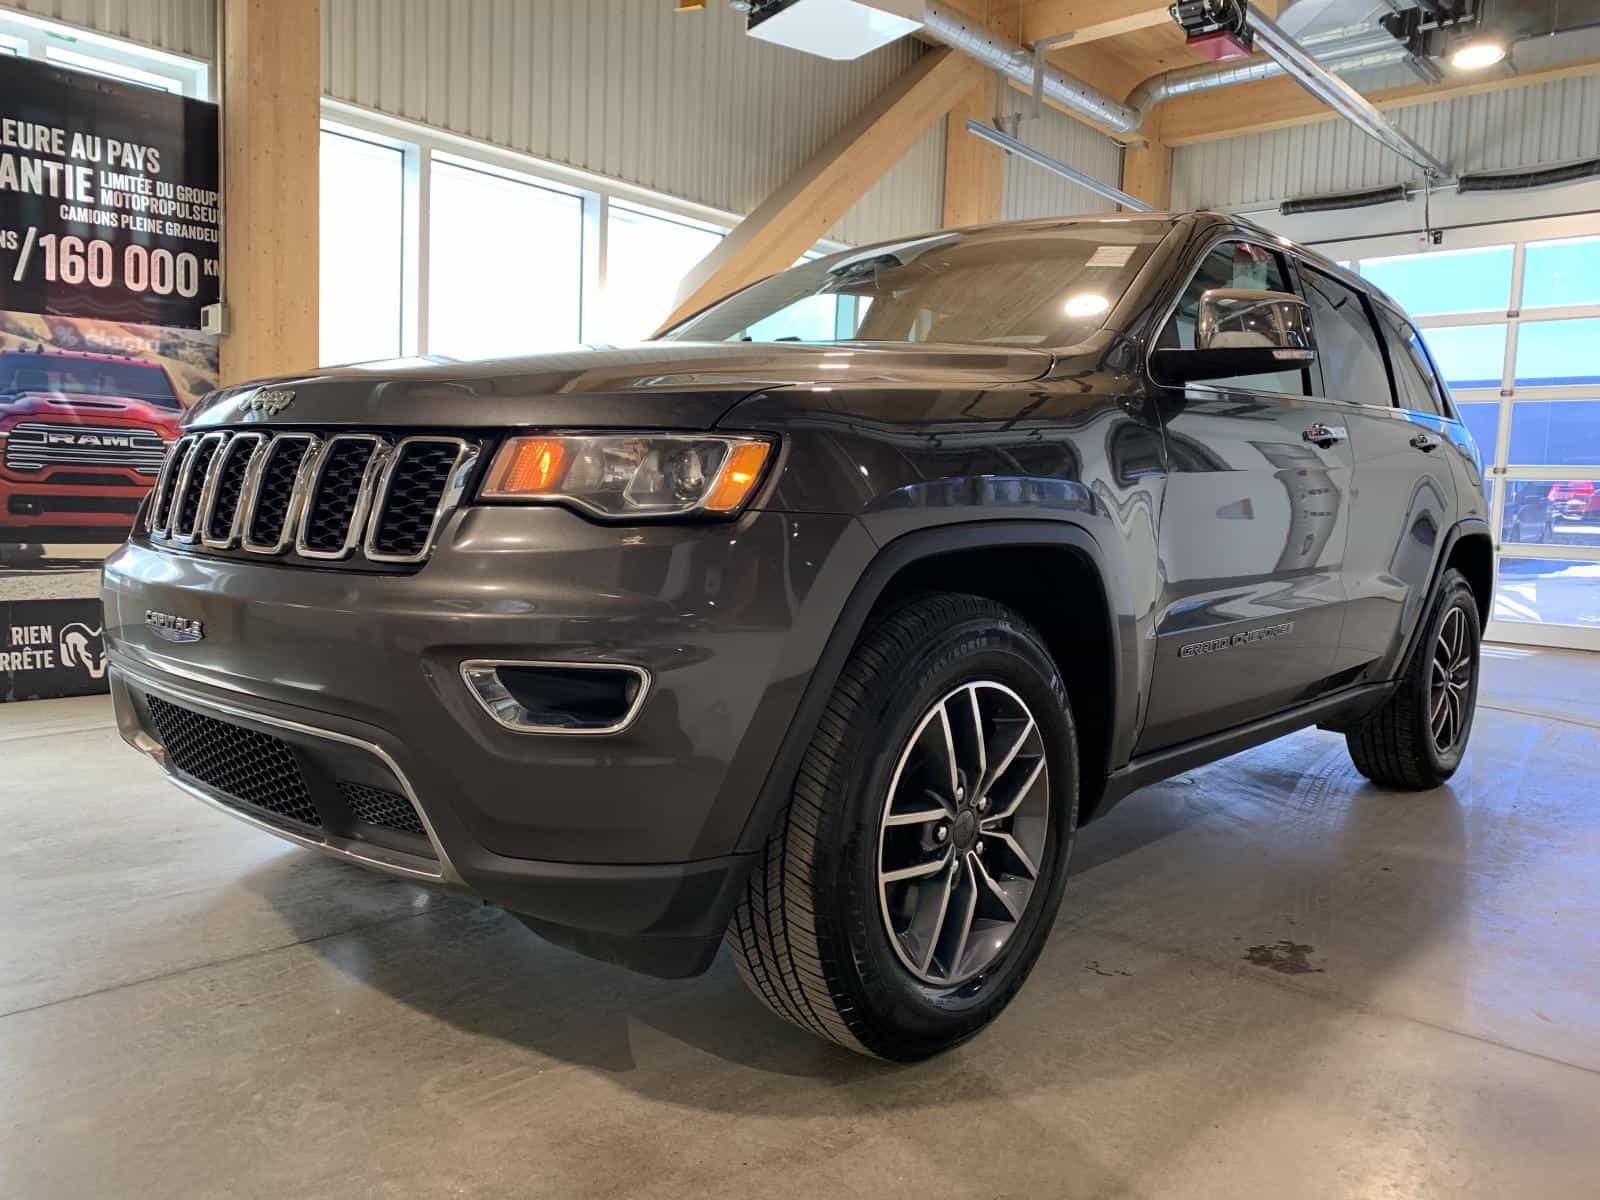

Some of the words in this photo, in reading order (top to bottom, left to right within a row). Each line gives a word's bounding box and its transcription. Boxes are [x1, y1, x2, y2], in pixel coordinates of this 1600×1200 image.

[0, 117, 65, 156] EURE
[71, 132, 101, 162] AU
[107, 138, 160, 174] PAYS
[0, 153, 95, 203] ANTIE
[100, 170, 153, 195] LIMITÉE
[156, 181, 174, 199] DU
[60, 204, 119, 228] CAMIONS
[121, 213, 164, 234] PLEINE
[48, 432, 129, 447] RAM
[11, 624, 53, 646] RIEN
[0, 646, 55, 671] RRÊTE
